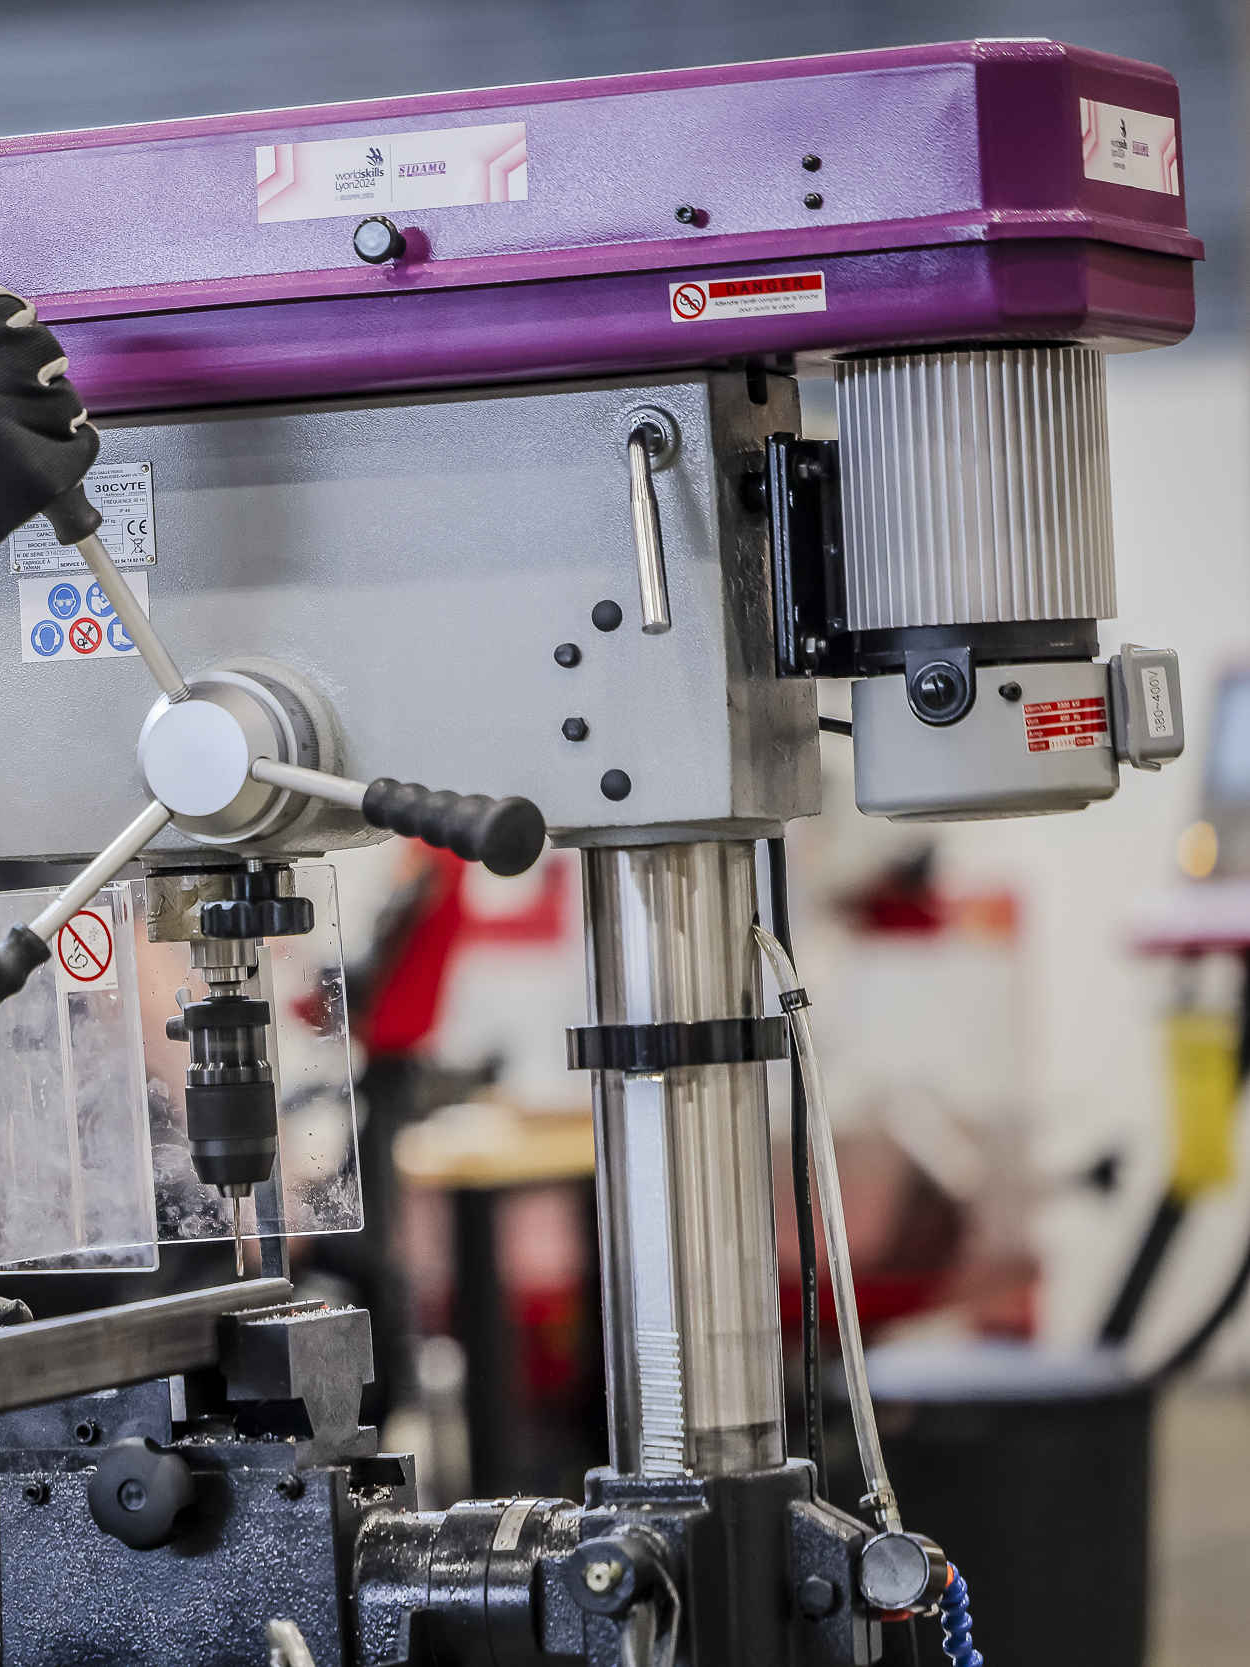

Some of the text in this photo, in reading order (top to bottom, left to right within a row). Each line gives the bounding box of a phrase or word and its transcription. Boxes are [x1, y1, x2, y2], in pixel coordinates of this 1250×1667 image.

[335, 167, 384, 181] worldskills
[398, 162, 446, 176] SIDAMO
[335, 178, 376, 192] Lyon2024
[726, 277, 804, 296] DANGER
[95, 481, 147, 493] 30CVTE
[127, 519, 148, 536] CE
[1026, 718, 1039, 726] Volt
[1028, 731, 1044, 739] Amp
